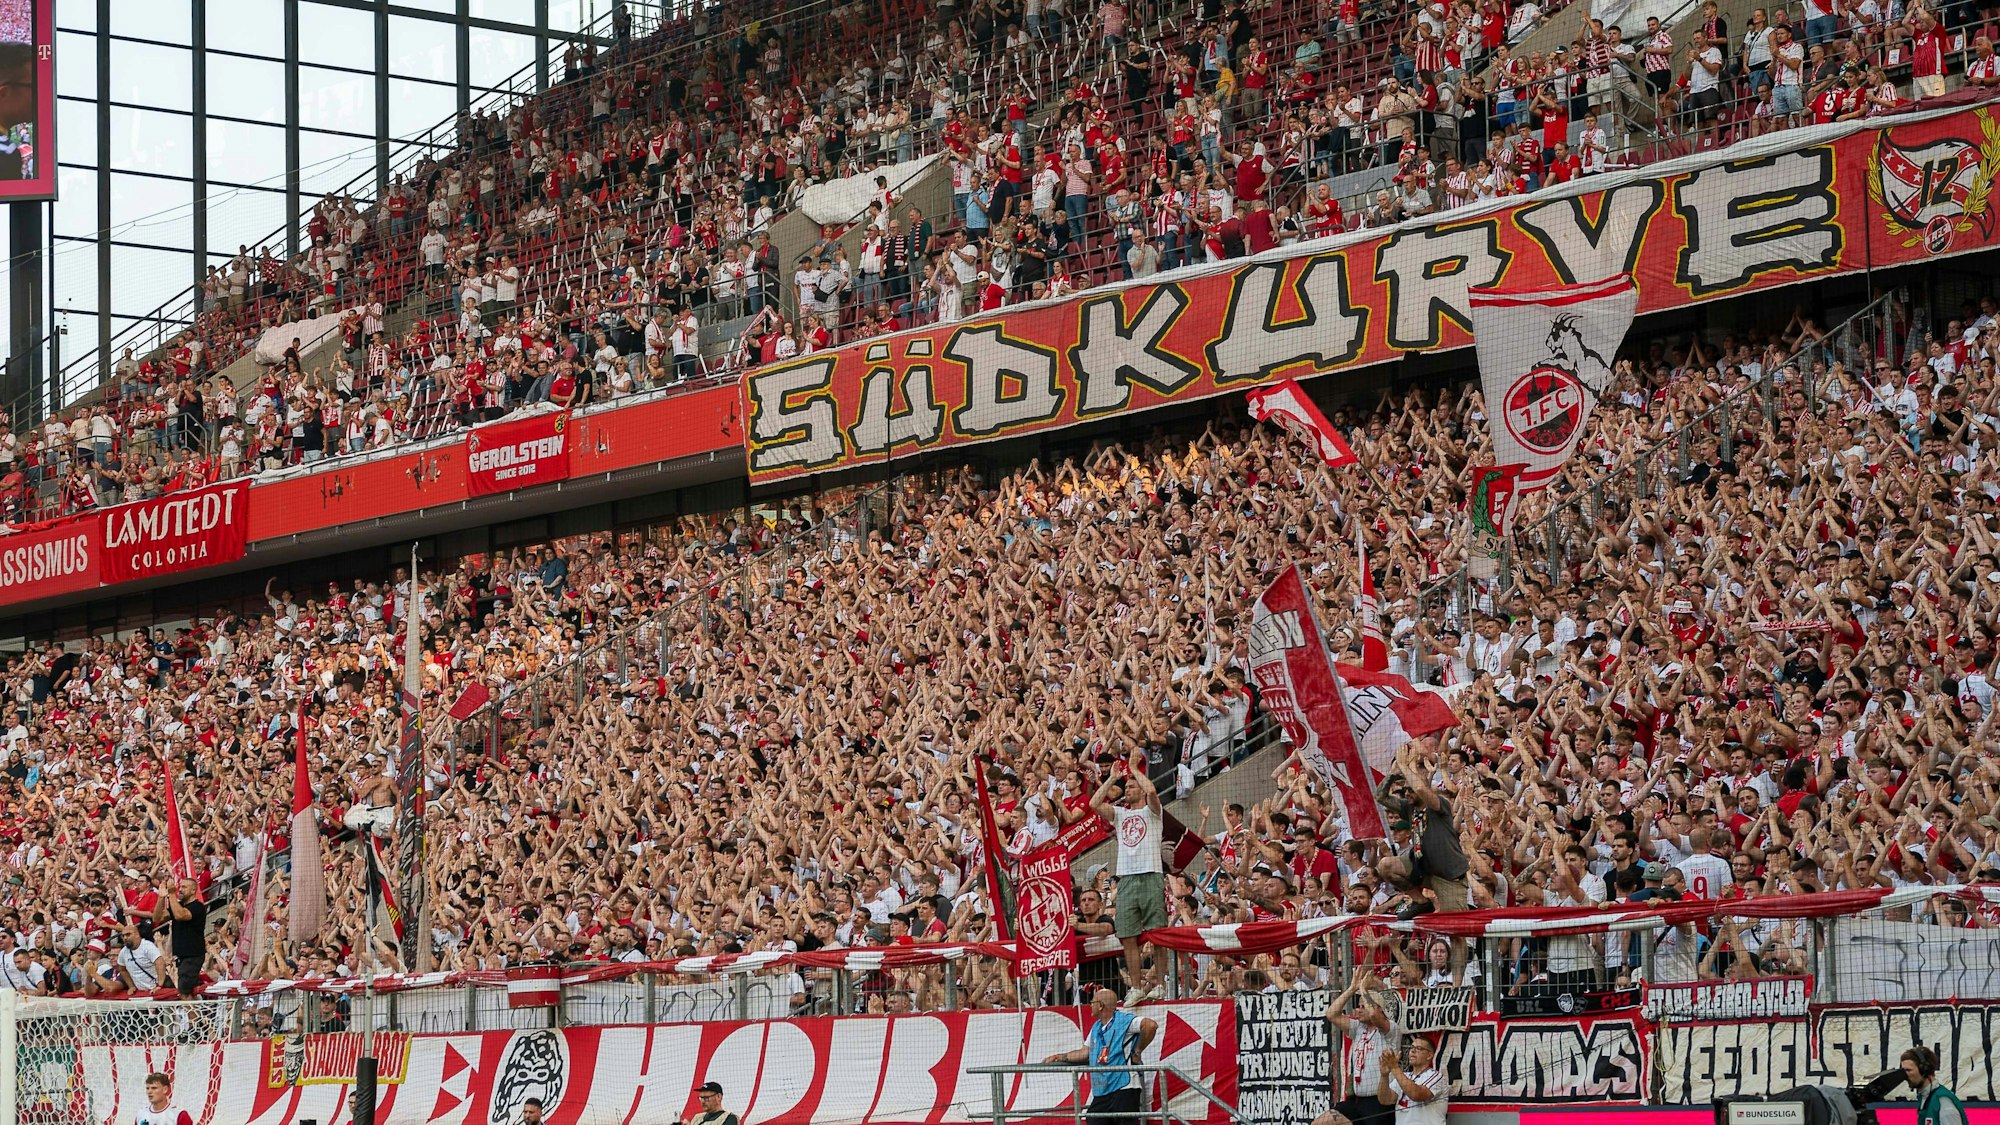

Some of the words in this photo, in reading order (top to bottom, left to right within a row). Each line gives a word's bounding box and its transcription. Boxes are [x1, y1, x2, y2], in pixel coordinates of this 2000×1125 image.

[1920, 157, 1960, 208] 12
[750, 147, 1845, 472] SÜDKURVE
[469, 434, 565, 474] GEROLSTEIN
[495, 467, 517, 481] SINCE
[518, 463, 536, 476] 2012
[106, 488, 238, 548] LAMSTEDT
[131, 541, 208, 571] COLONIA
[1025, 853, 1068, 878] WILLE
[1693, 876, 1708, 900] 9
[1240, 989, 1330, 1020] VIRAGE
[1408, 986, 1471, 1008] DIFFIDATI
[1240, 1020, 1328, 1050] AUTEUIL
[271, 1043, 285, 1083] SEK
[303, 1032, 408, 1079] STADIONRBOT
[1236, 1052, 1315, 1079] TRIBUNE
[1317, 1050, 1330, 1077] G
[1746, 1110, 1797, 1118] BUNDESLIGA
